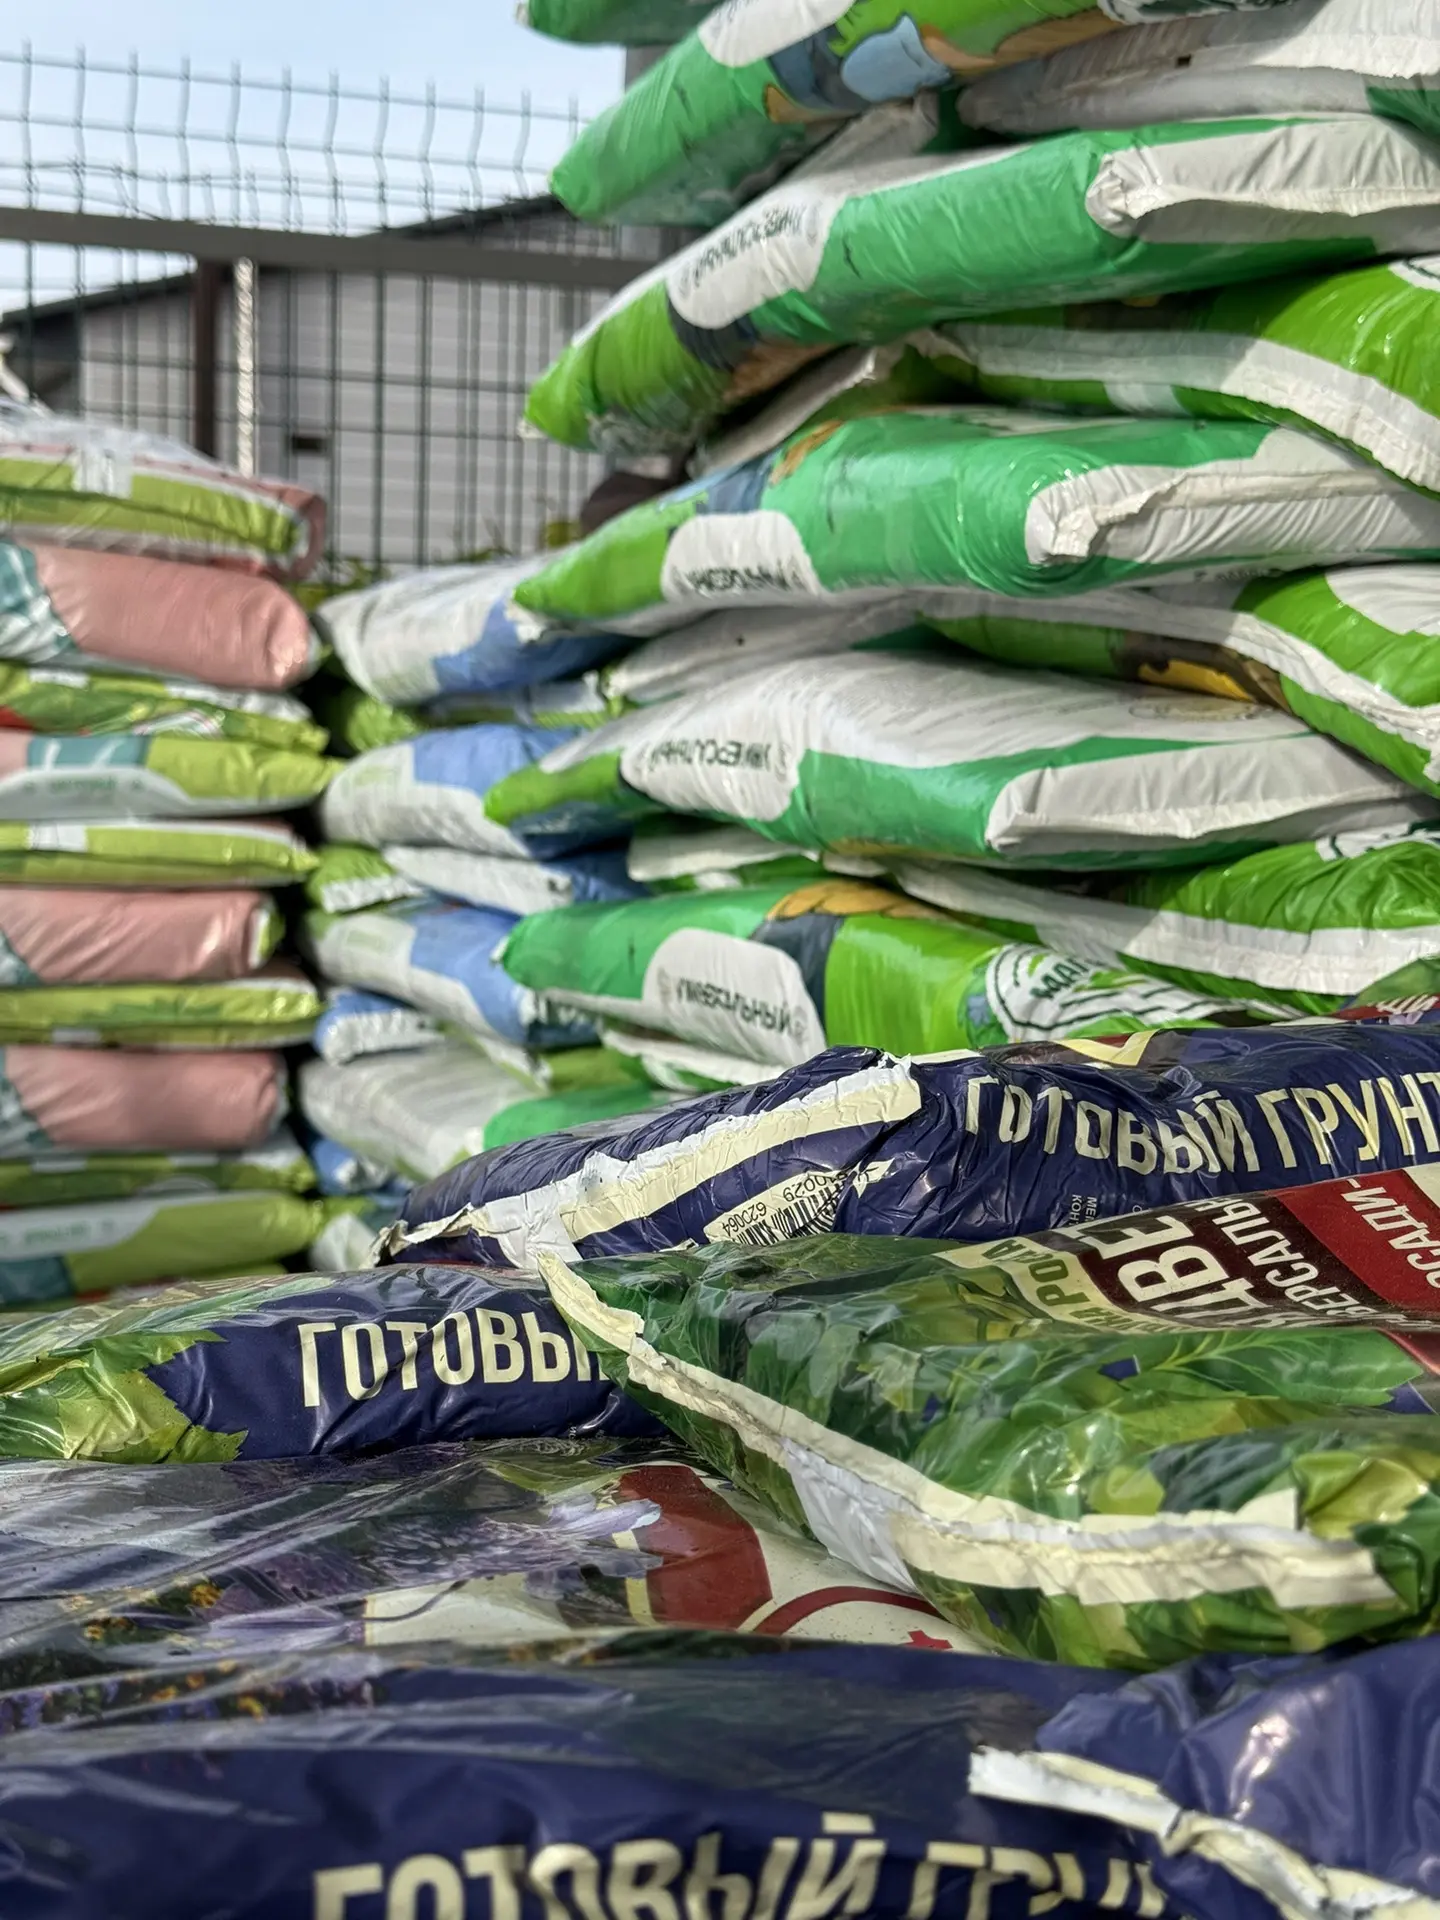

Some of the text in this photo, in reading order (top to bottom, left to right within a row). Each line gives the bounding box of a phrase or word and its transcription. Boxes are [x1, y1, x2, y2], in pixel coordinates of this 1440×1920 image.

[965, 1075, 1260, 1176] ГОТОВЫЙ
[722, 1201, 767, 1238] 620064
[1340, 1177, 1440, 1290] САДИ-
[297, 1307, 611, 1408] ГОТОВЫ
